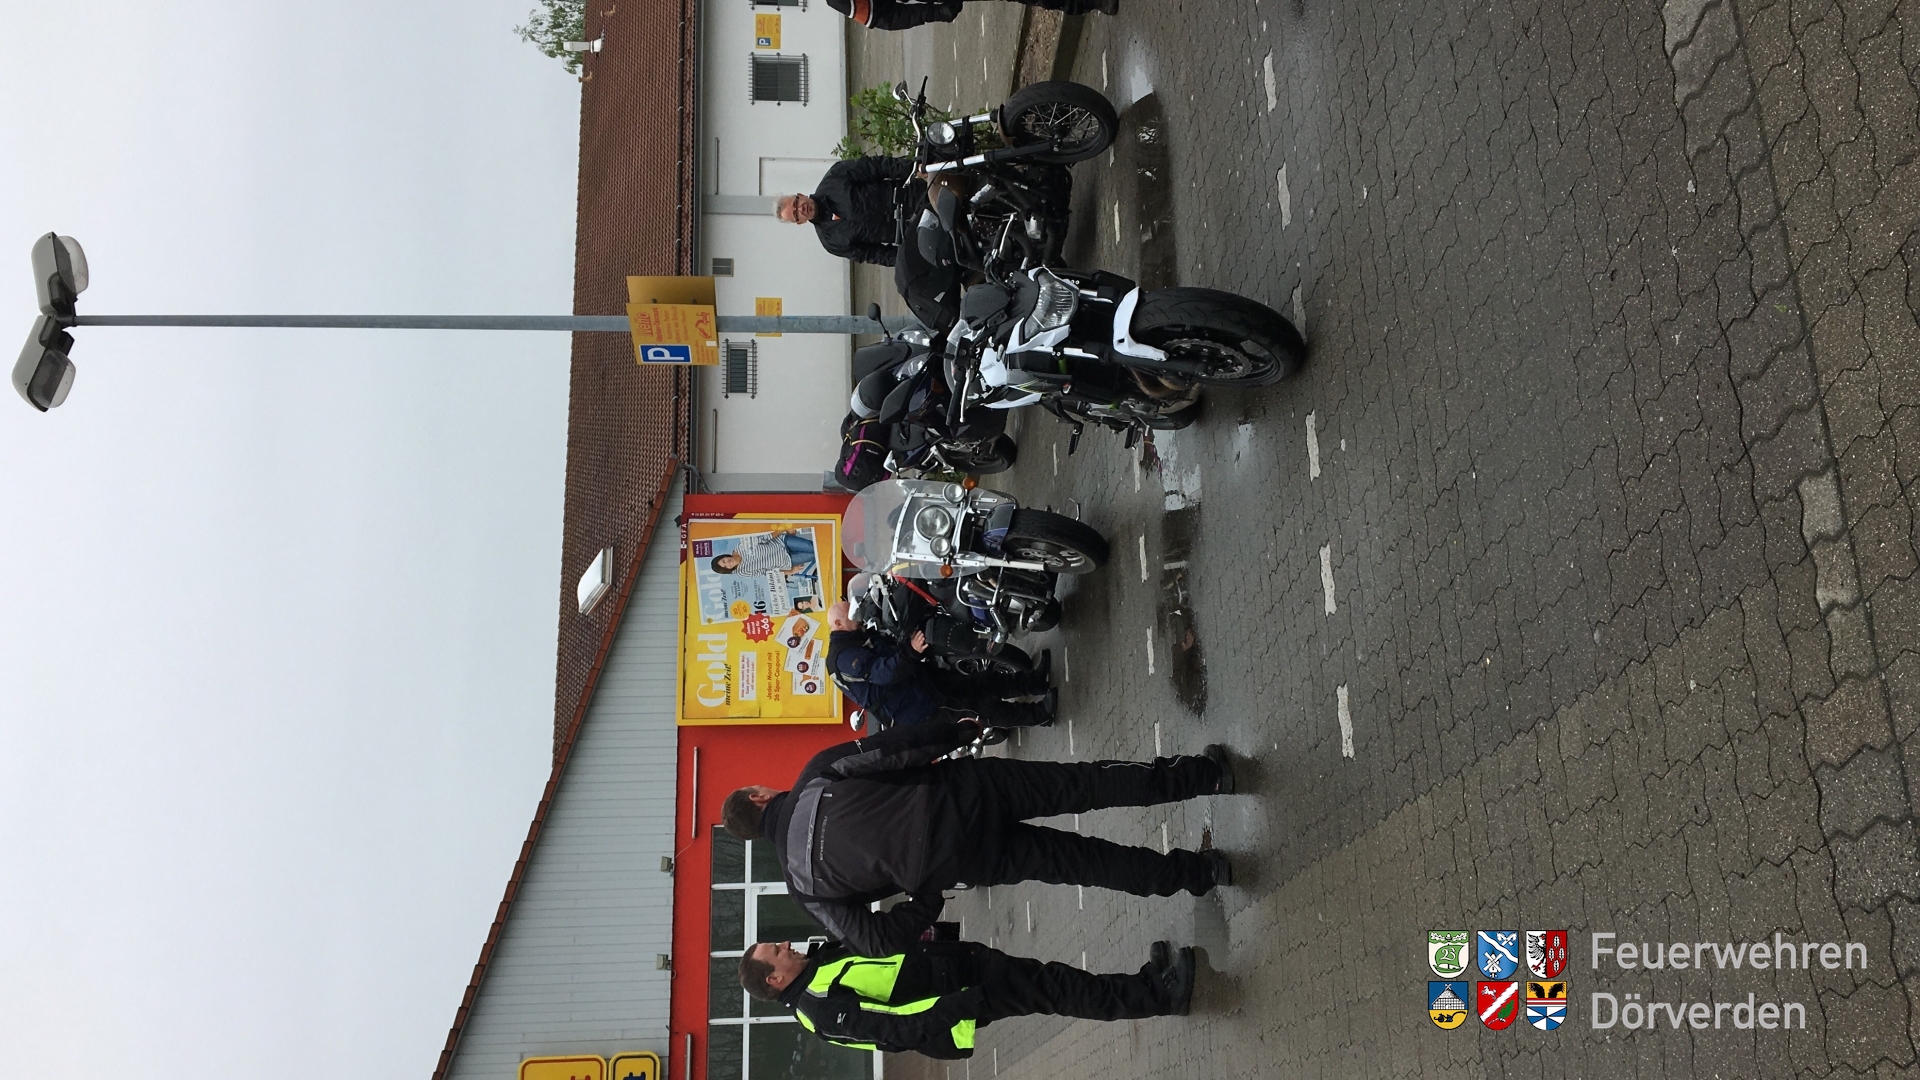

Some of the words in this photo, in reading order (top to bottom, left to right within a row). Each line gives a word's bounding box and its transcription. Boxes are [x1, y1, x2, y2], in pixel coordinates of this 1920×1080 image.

[758, 38, 769, 46] P
[635, 312, 653, 336] Netto
[647, 347, 685, 361] P
[699, 570, 725, 620] Gold
[696, 632, 728, 708] Gold
[723, 663, 732, 681] Zeit!
[774, 694, 780, 702] 26
